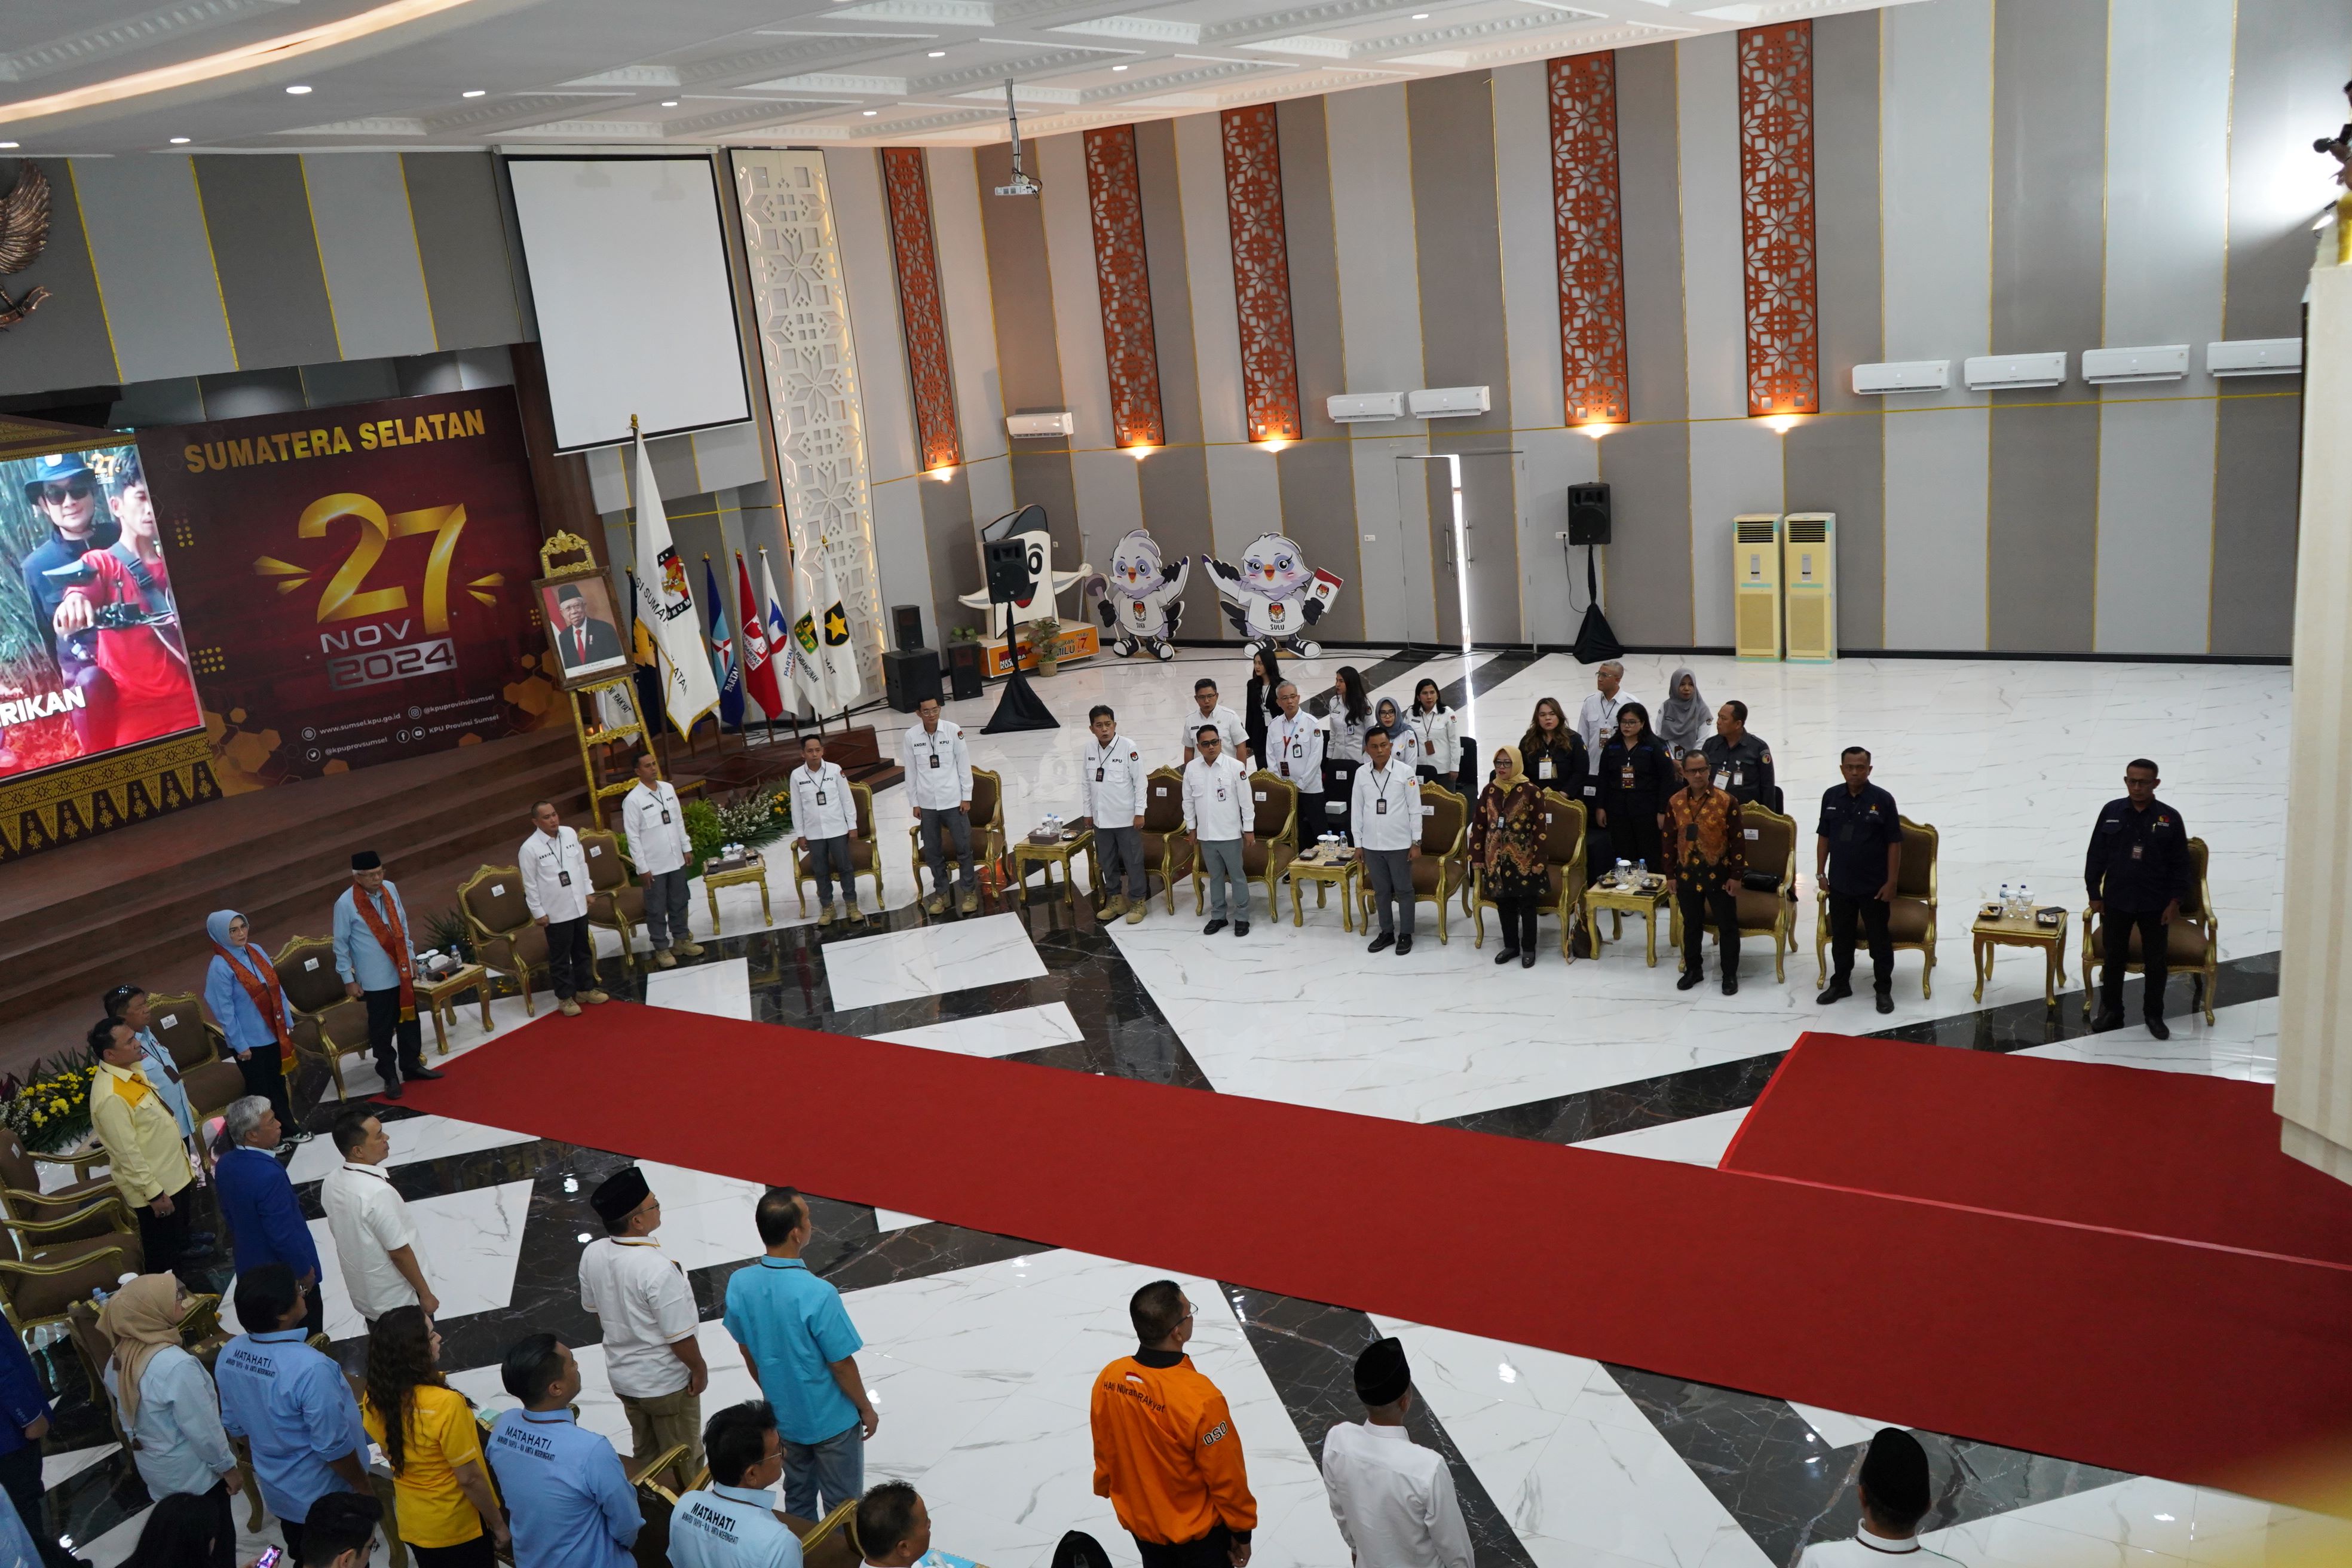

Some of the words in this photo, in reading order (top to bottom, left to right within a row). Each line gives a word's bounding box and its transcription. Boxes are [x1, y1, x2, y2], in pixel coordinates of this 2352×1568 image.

[184, 426, 353, 473] SUMATERA
[359, 409, 486, 450] SELATAN
[91, 452, 115, 477] 27
[299, 492, 467, 635] 27
[320, 618, 411, 654] NOV
[333, 642, 454, 687] 2024
[795, 651, 819, 683] PEMBANGUNAN
[0, 685, 86, 727] RIKAN
[423, 694, 495, 715] @kpuprovinsisumsel
[612, 693, 632, 714] RAKYAT
[319, 712, 401, 735] www.sumsel.kpu.go.id
[428, 725, 444, 734] KPU
[445, 719, 473, 731] Provinsi
[474, 713, 500, 725] Sumsel
[325, 736, 388, 756] @kpuprovsumsel
[233, 1348, 272, 1368] MATAHATI
[1116, 1383, 1138, 1397] NUran
[1137, 1393, 1166, 1414] RAkyat
[505, 1425, 552, 1450] MATAHATI
[1202, 1420, 1228, 1446] OSO
[690, 1502, 736, 1532] MATAHATI
